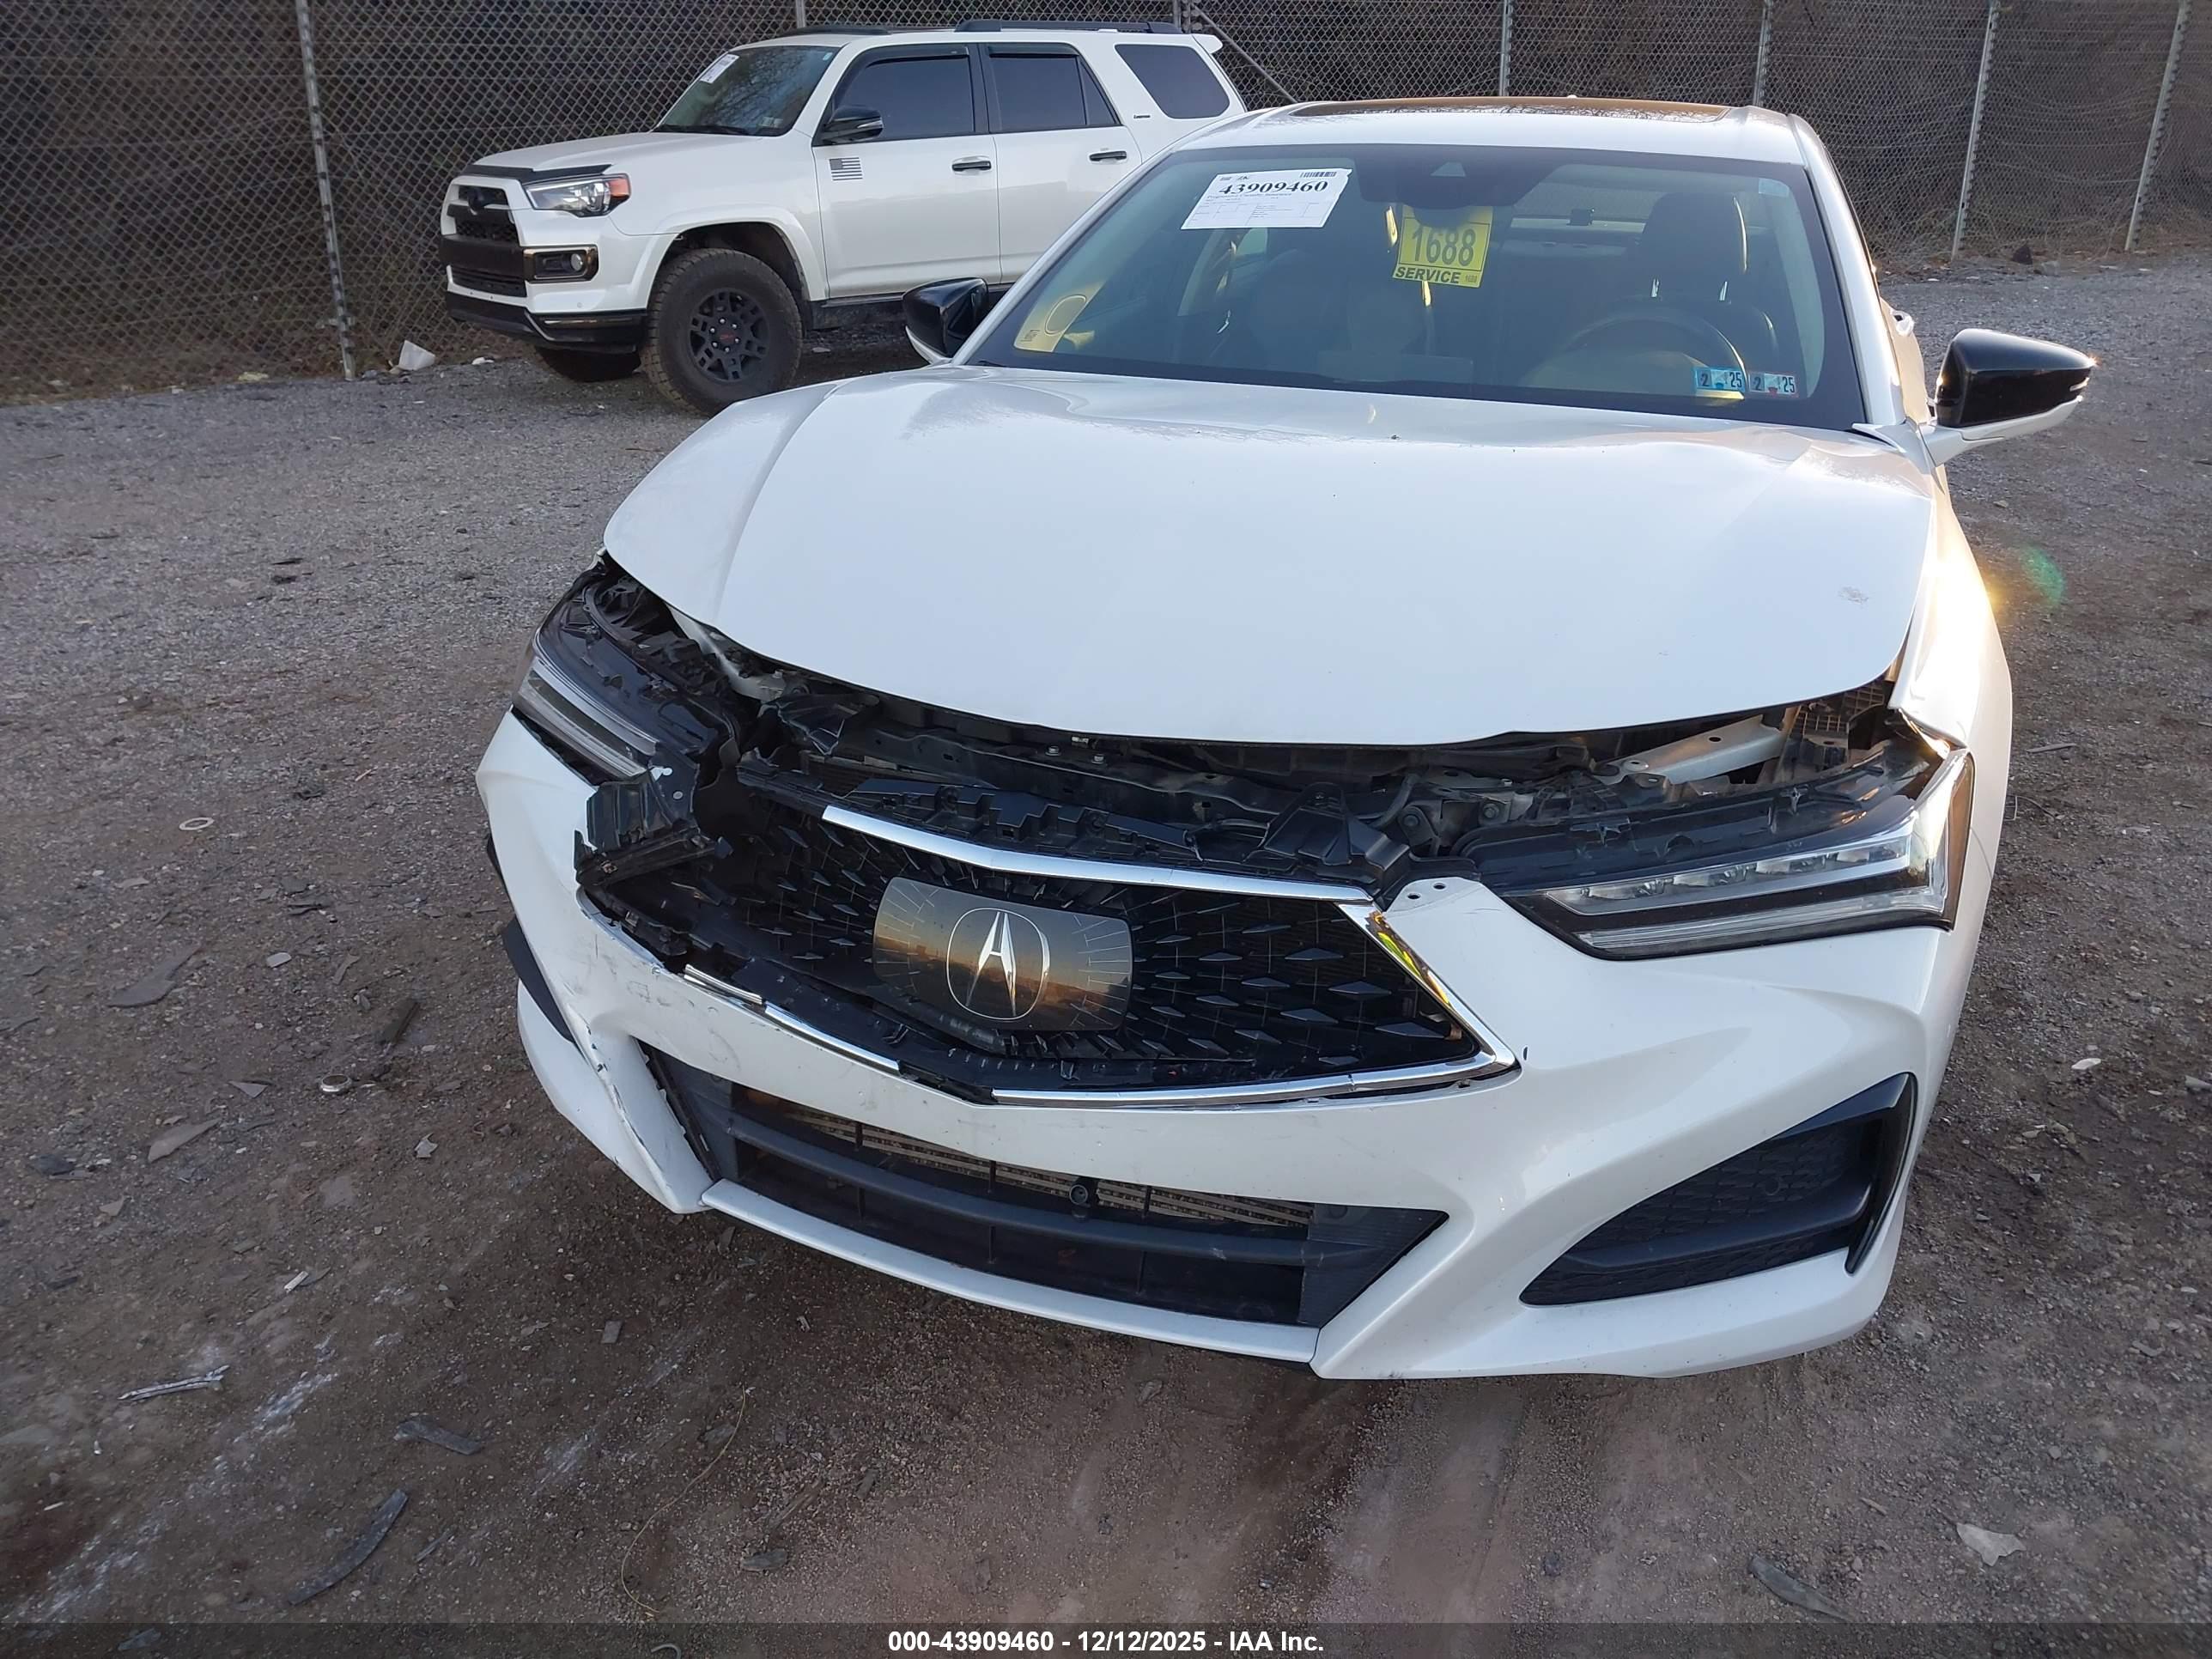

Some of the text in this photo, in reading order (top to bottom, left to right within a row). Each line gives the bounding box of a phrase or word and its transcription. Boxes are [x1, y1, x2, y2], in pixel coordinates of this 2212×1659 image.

[1218, 180, 1328, 195] 43909460
[1411, 226, 1477, 267] 1688
[1395, 266, 1462, 284] SERVICE
[1701, 372, 1743, 388] 2 25
[1754, 376, 1796, 393] 2 25
